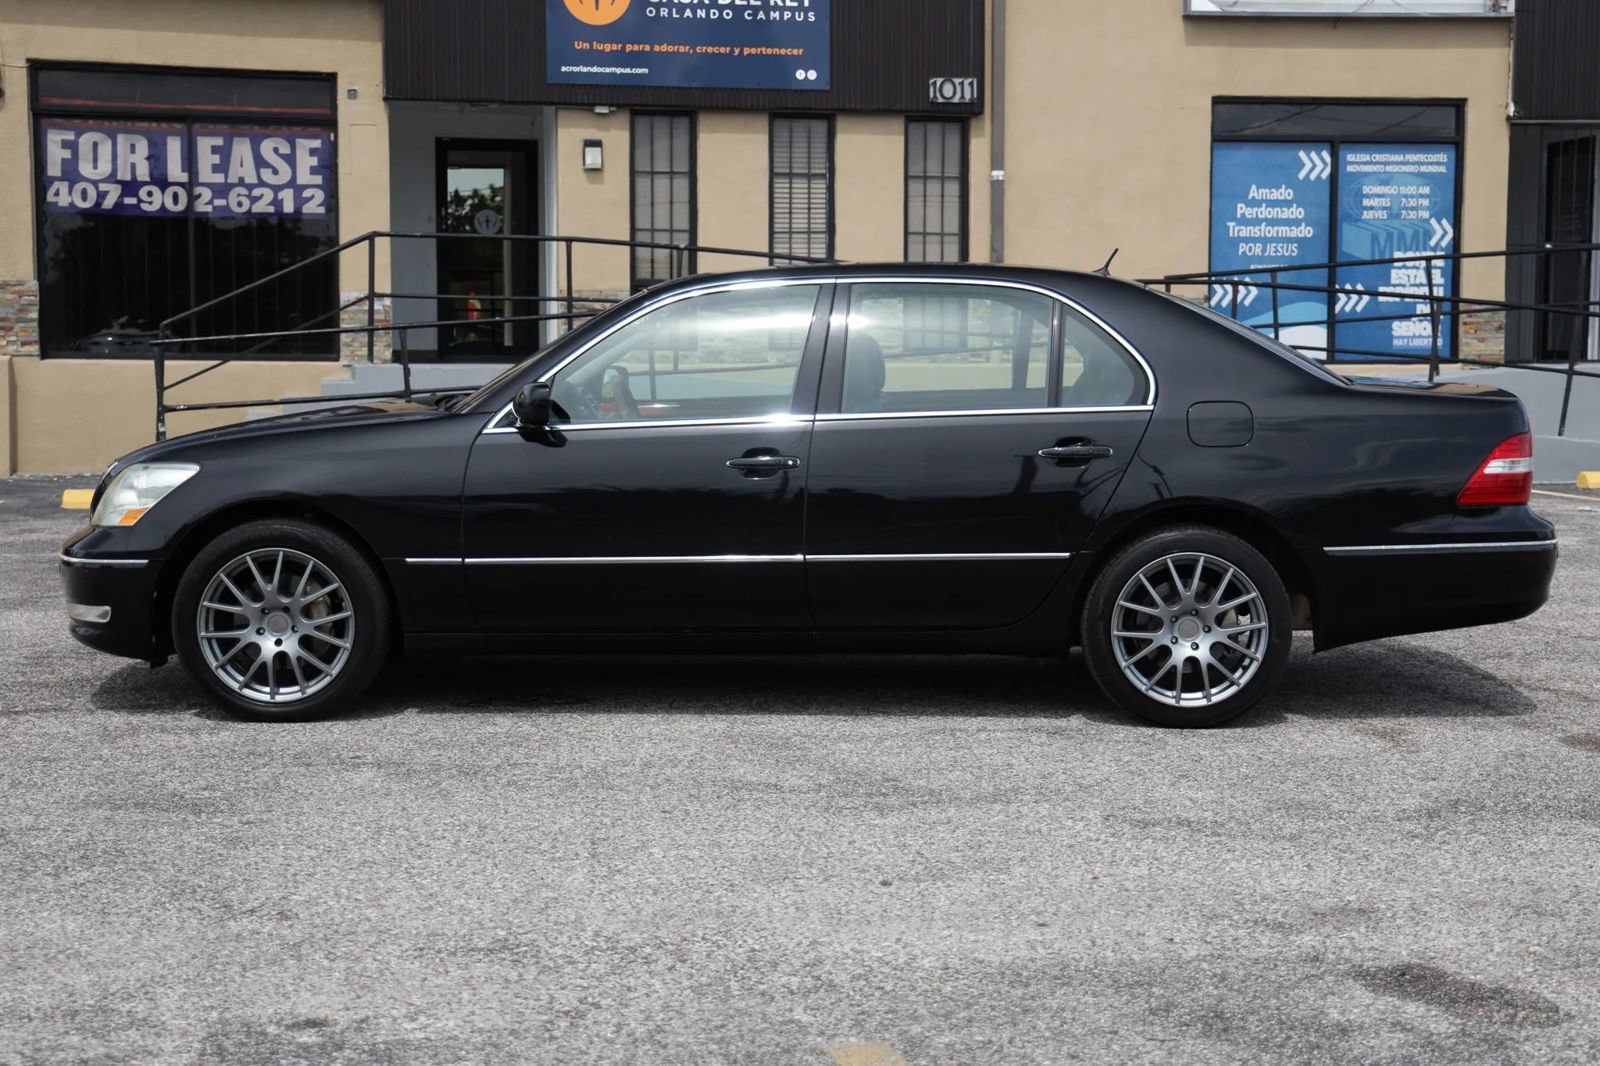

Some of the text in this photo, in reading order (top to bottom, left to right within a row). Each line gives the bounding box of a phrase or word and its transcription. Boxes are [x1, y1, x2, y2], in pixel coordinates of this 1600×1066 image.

[646, 7, 816, 21] ORLANDO CAMPUS
[574, 41, 804, 56] Un lugar para adorar, crecer y pertenecer
[560, 65, 649, 75] acrorlandocampus.com
[929, 78, 977, 102] 1011
[47, 129, 323, 185] FOR LEASE
[1346, 153, 1371, 162] IGLESIA
[1371, 153, 1405, 162] CRISTIANA
[1346, 165, 1447, 173] MOVIMIENTO MISIONERO MUNDIAL
[1248, 184, 1294, 200] Amado
[1362, 185, 1431, 195] DOMINGO 11:00 AM
[46, 181, 326, 214] 407-902-6212
[1362, 198, 1430, 207] MARTES 7:30 PM
[1236, 203, 1305, 219] Perdonado
[1362, 210, 1430, 219] JUEVES 7:30 PM
[1226, 222, 1314, 238] Transformado
[1238, 243, 1298, 256] POR JESUS
[1393, 337, 1443, 347] HAY LIBERTD
